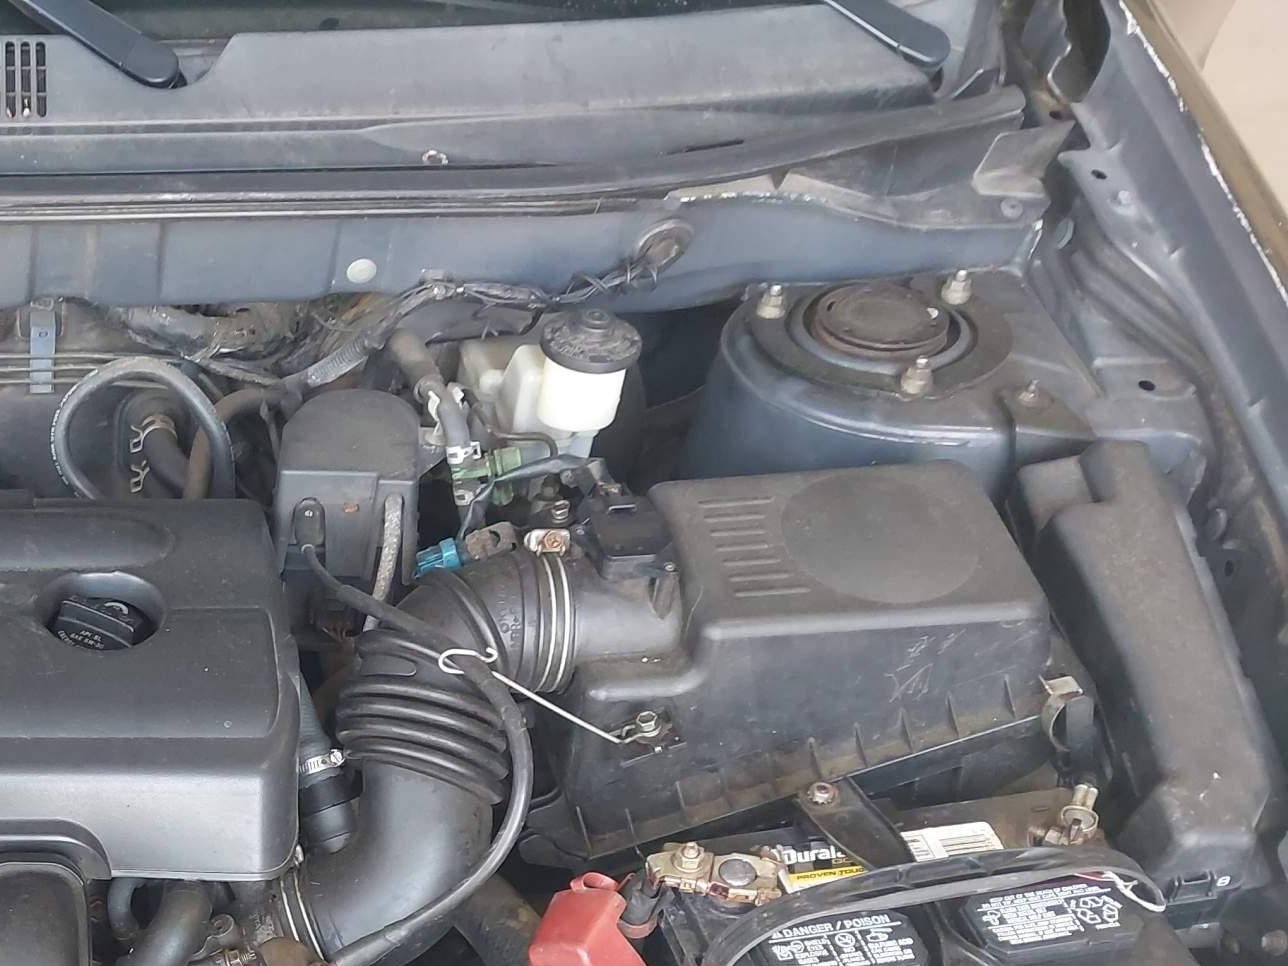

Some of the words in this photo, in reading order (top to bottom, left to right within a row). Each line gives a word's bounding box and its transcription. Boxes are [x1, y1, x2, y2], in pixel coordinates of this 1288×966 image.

[796, 871, 837, 880] PROVEN
[782, 922, 834, 938] DANGER
[843, 914, 891, 929] POISON
